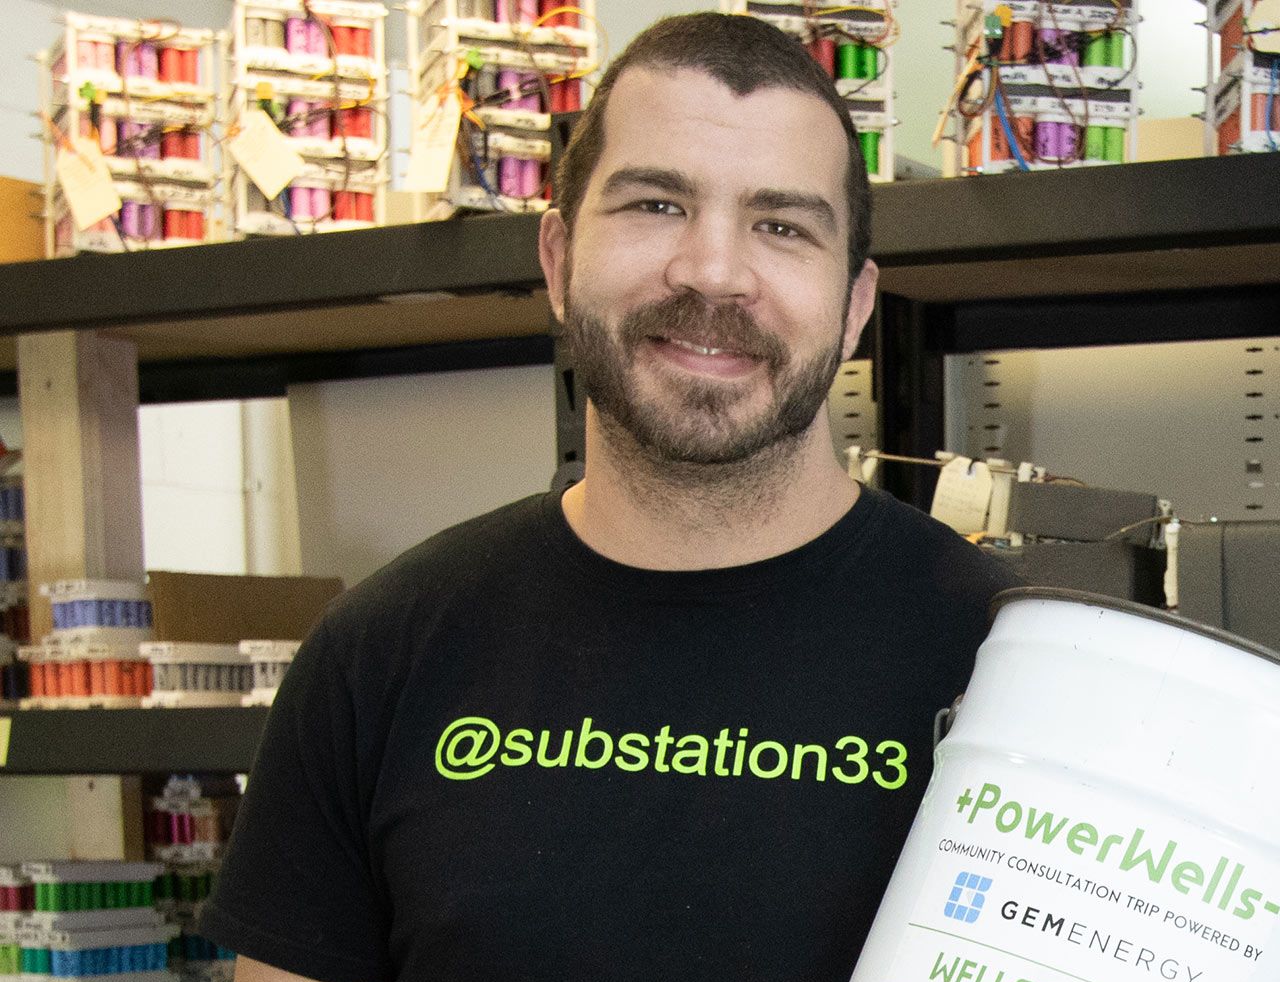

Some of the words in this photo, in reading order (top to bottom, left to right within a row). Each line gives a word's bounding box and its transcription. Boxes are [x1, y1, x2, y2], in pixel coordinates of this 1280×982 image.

[434, 716, 909, 790] @substation33
[938, 838, 1006, 865] COMMUNITY
[1007, 855, 1122, 904] CONSULTATION
[1126, 894, 1160, 918] TRIP
[1163, 910, 1241, 953] POWERED
[1243, 944, 1264, 963] BY
